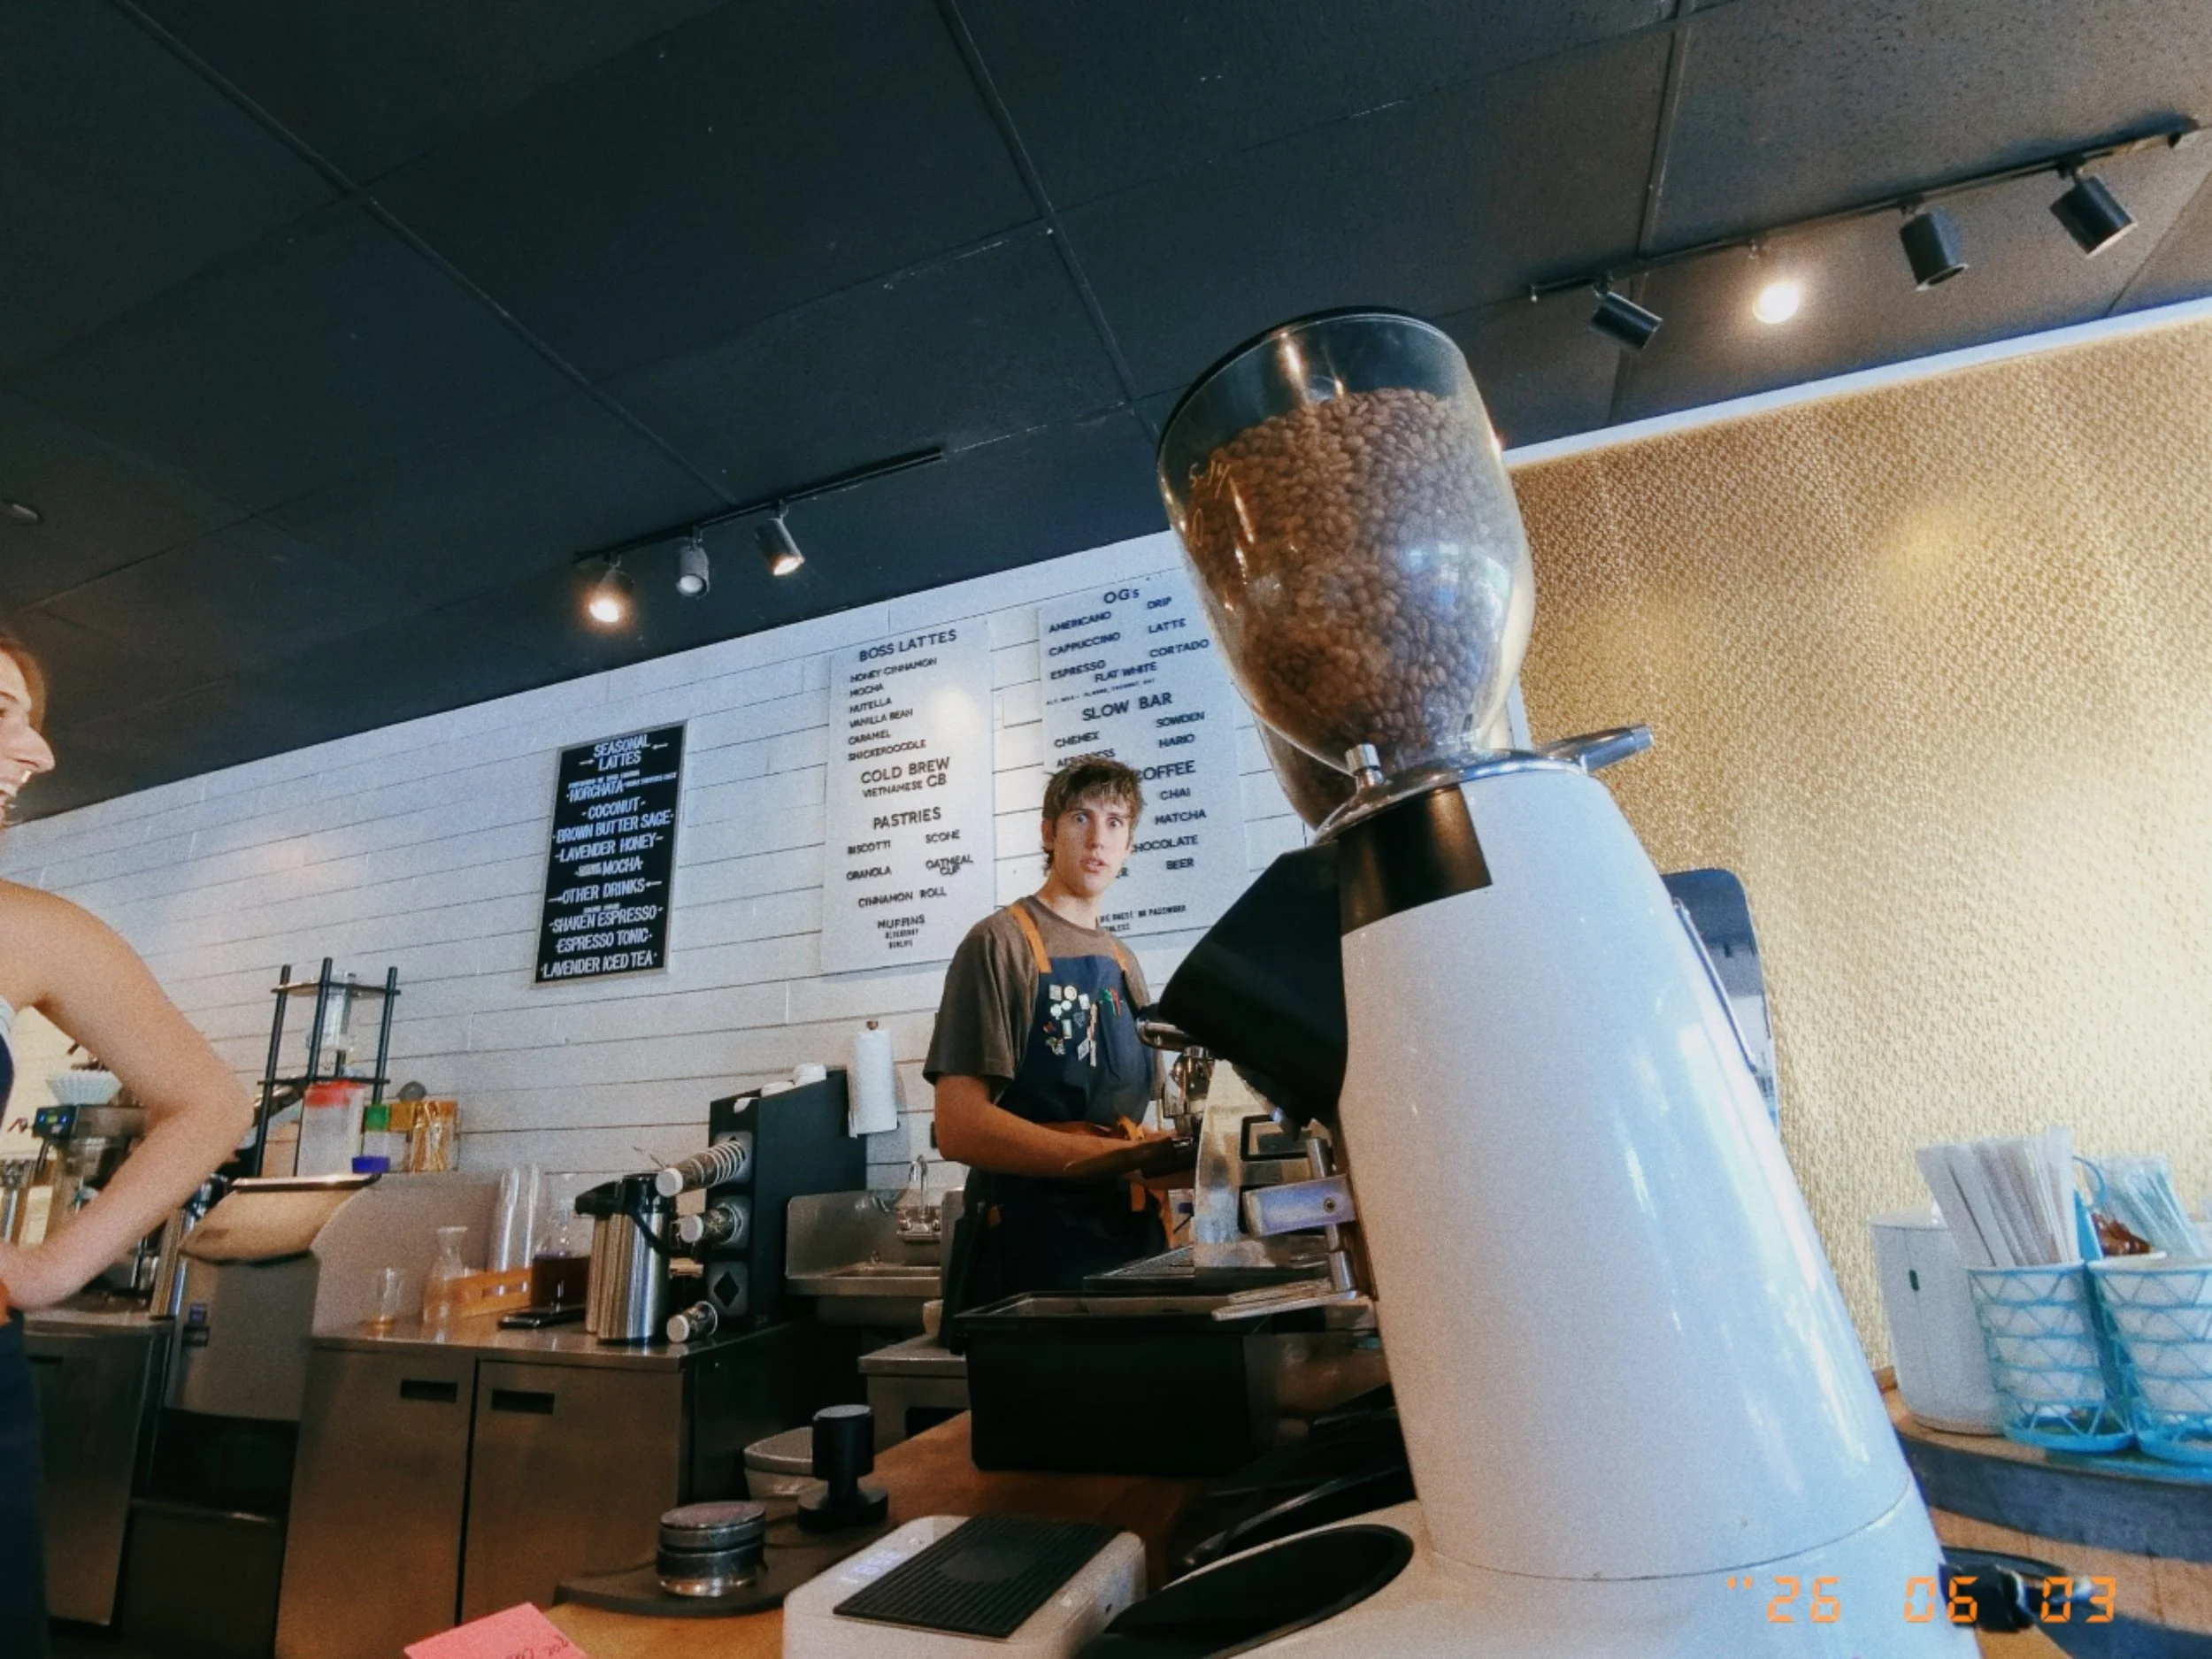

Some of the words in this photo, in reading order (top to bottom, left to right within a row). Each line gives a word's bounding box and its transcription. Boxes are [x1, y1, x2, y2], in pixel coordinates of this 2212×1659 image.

[1147, 596, 1172, 611] DRIP
[1048, 611, 1112, 634] AMERICANO
[1148, 618, 1187, 634] LATTE
[858, 642, 895, 662] BOSS
[898, 629, 957, 652] LATTES
[1048, 632, 1121, 657] CAPPUCCINO
[1148, 638, 1210, 658] CORTADO
[849, 668, 881, 683] HONEY
[883, 657, 938, 675] CINNAMON
[1050, 659, 1107, 680] ESPRESSO
[1094, 669, 1119, 683] FLAT
[1122, 662, 1157, 677] WHITE
[849, 682, 883, 697] MOCHA
[849, 697, 892, 713] NUTELLA
[1081, 699, 1130, 721] SLOW
[1138, 691, 1173, 710] BAR
[849, 714, 887, 728] VANILLA
[889, 708, 913, 720] BEAN
[1156, 710, 1206, 728] SOWDEN
[594, 734, 649, 757] SEASONAL
[848, 729, 891, 745] CARAMEL
[1054, 730, 1101, 748] CHEMEX
[1158, 733, 1196, 749] HARIO
[598, 750, 641, 771] LATTES
[860, 766, 902, 784] COLD
[909, 757, 950, 775] BREW
[569, 780, 624, 803] HORCHATA
[862, 780, 923, 798] VIETNAMESE
[926, 772, 947, 787] CB
[1159, 787, 1192, 801] CHAI
[588, 796, 641, 819] COCONUT
[872, 806, 941, 830] PASTRIES
[1155, 809, 1208, 825] MATCHA
[556, 824, 594, 844] BROWN
[595, 816, 639, 837] BUTTER
[640, 809, 672, 828] SAGE
[926, 829, 960, 843] SCONE
[559, 840, 616, 863] LAVENDER
[619, 833, 657, 853] HONEY
[847, 840, 891, 856] BISCOTTI
[603, 856, 642, 876] MOCHA
[926, 854, 973, 869] OATMEAL
[940, 864, 961, 875] CUP
[1166, 857, 1195, 870] BEER
[846, 866, 892, 880] GRANOLA
[562, 885, 599, 904] OTHER
[603, 878, 645, 898] DRINKS
[858, 891, 913, 908] CINNAMON
[920, 887, 947, 899] ROLL
[552, 914, 595, 933] SHAKEN
[597, 905, 657, 927] ESPRESSO
[877, 914, 926, 929] MUFFINS
[557, 931, 614, 954] ESPRESSO
[617, 927, 649, 946] TONIC
[542, 956, 601, 979] LAVENDER
[603, 953, 629, 972] ICED
[630, 949, 653, 967] TEA
